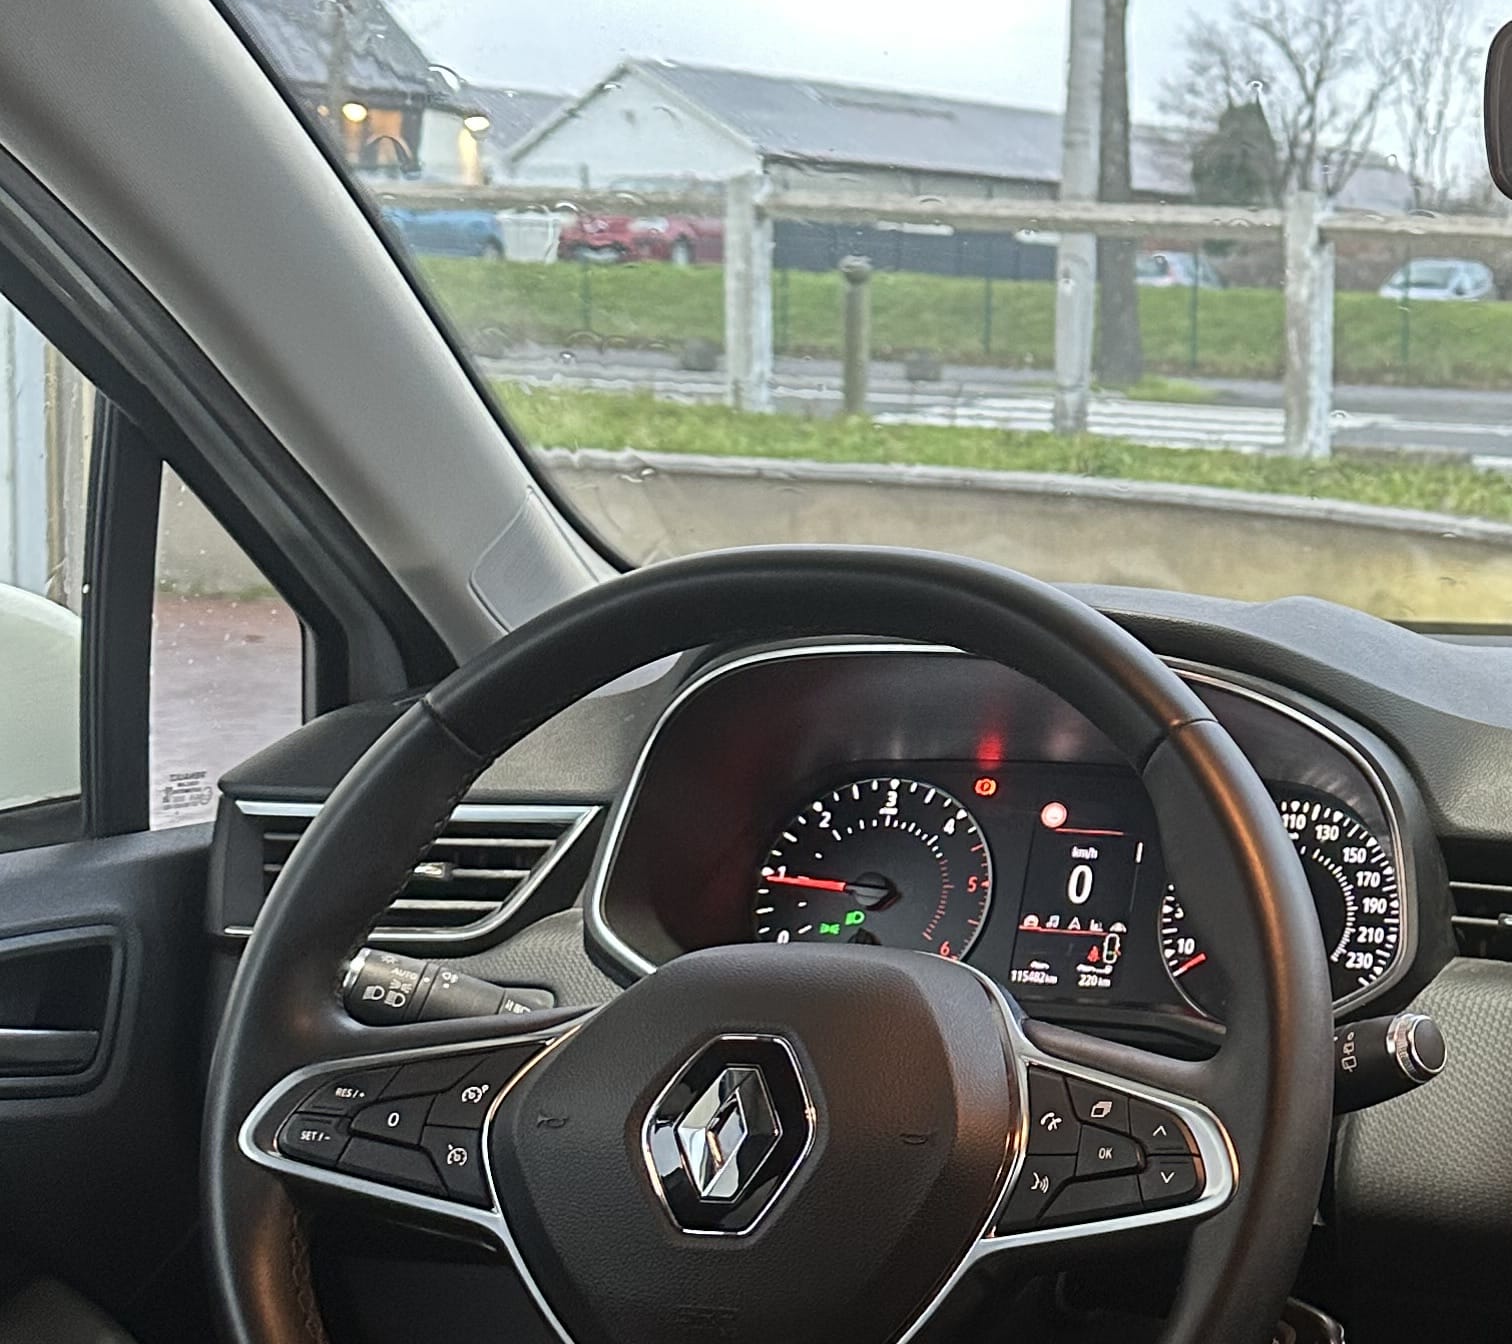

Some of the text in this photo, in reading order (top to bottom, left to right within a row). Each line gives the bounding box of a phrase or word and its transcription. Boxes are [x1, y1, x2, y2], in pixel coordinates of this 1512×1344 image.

[887, 791, 898, 807] 3
[819, 811, 831, 828] 2
[943, 818, 955, 834] 4
[1282, 813, 1307, 830] 110
[1315, 824, 1339, 841] 130
[1072, 846, 1098, 859] km/h
[1342, 847, 1367, 863] 150
[968, 876, 978, 893] 5
[1068, 864, 1093, 905] 0
[1356, 871, 1381, 887] 170
[1362, 897, 1387, 914] 190
[1357, 926, 1384, 943] 210
[940, 941, 950, 956] 6
[1177, 938, 1195, 954] 10
[1345, 951, 1373, 969] 230
[391, 967, 418, 980] AUTO
[1098, 1148, 1113, 1159] OK
